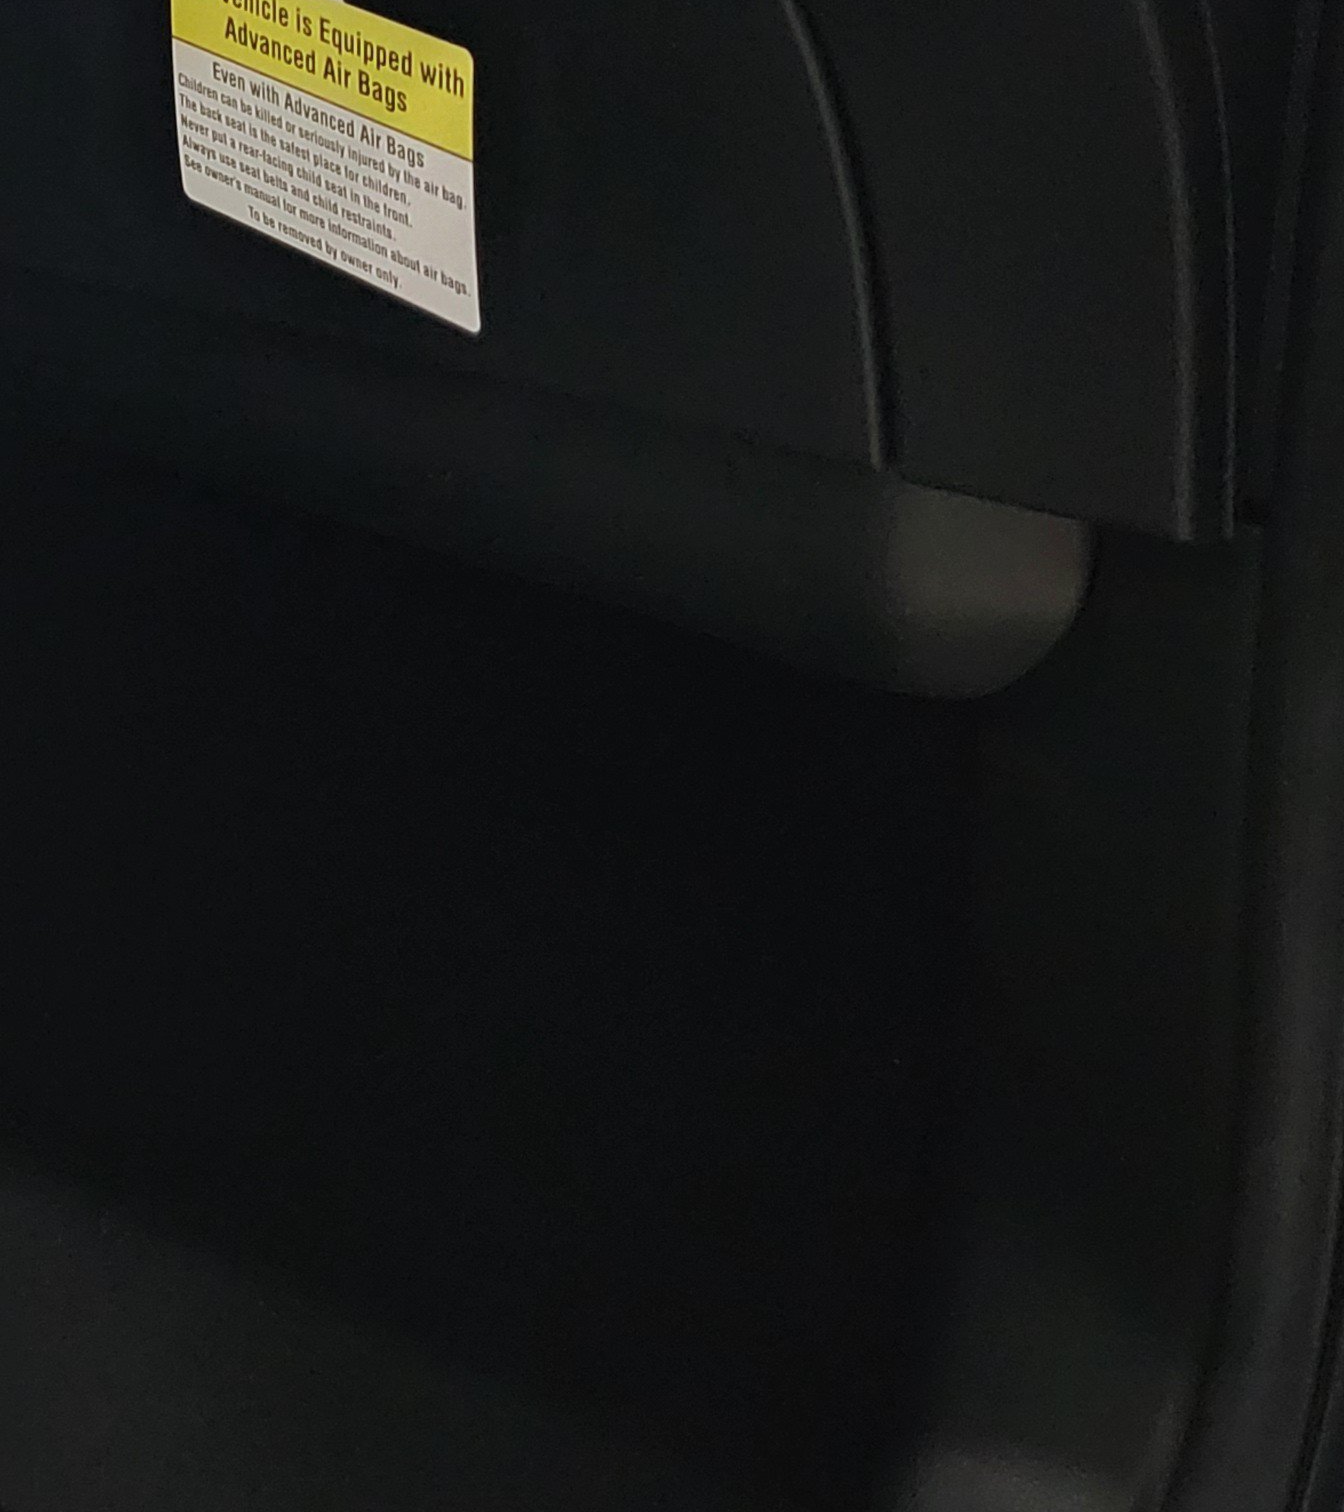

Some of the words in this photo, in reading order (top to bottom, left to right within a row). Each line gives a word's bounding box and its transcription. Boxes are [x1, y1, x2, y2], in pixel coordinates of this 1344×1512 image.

[225, 16, 316, 76] Advanced
[323, 56, 351, 89] Air
[358, 69, 408, 113] Bags
[296, 7, 312, 37] is
[319, 16, 412, 78] Equipped
[420, 61, 464, 99] with
[178, 72, 218, 101] Children
[221, 92, 238, 110] can
[240, 98, 253, 115] be
[255, 105, 283, 129] killed
[285, 120, 295, 134] or
[298, 126, 345, 159] seriously
[348, 146, 385, 173] injured
[388, 162, 401, 183] by
[403, 170, 421, 189] the
[424, 181, 439, 197] air
[442, 185, 467, 210] bag.
[179, 93, 197, 112] The
[200, 101, 222, 123] back
[225, 115, 246, 133] seat
[248, 124, 258, 139] is
[260, 129, 277, 147] the
[279, 136, 310, 162] safest
[313, 154, 341, 175] place
[344, 165, 359, 183] for
[212, 61, 245, 92] Even
[250, 80, 279, 106] with
[284, 92, 355, 138] Advanced
[360, 125, 382, 150] Air
[386, 135, 425, 168] Bags
[180, 113, 209, 136] Never
[212, 129, 227, 146] put
[230, 138, 236, 149] a
[238, 142, 294, 177] rear-facing
[296, 167, 322, 188] child
[325, 179, 347, 200] seat
[350, 189, 360, 205] in
[363, 194, 380, 213] the
[383, 203, 413, 228] front.
[182, 134, 216, 160] Always
[219, 152, 237, 169] use
[239, 161, 260, 180] seat
[263, 169, 288, 192] belts
[291, 184, 310, 202] and
[313, 194, 338, 215] child
[341, 207, 396, 241] restraints.
[184, 154, 202, 173] See
[204, 165, 242, 191] owner's
[244, 183, 280, 208] manual
[283, 199, 297, 216] for
[299, 208, 325, 229] more
[328, 219, 388, 258] information
[390, 250, 420, 274] about
[423, 264, 438, 282] air
[441, 271, 471, 297] bags.
[248, 205, 260, 222] To
[262, 211, 275, 228] be
[278, 221, 322, 251] removed
[325, 240, 337, 261] by
[340, 251, 373, 274] owner
[375, 267, 402, 289] only.
